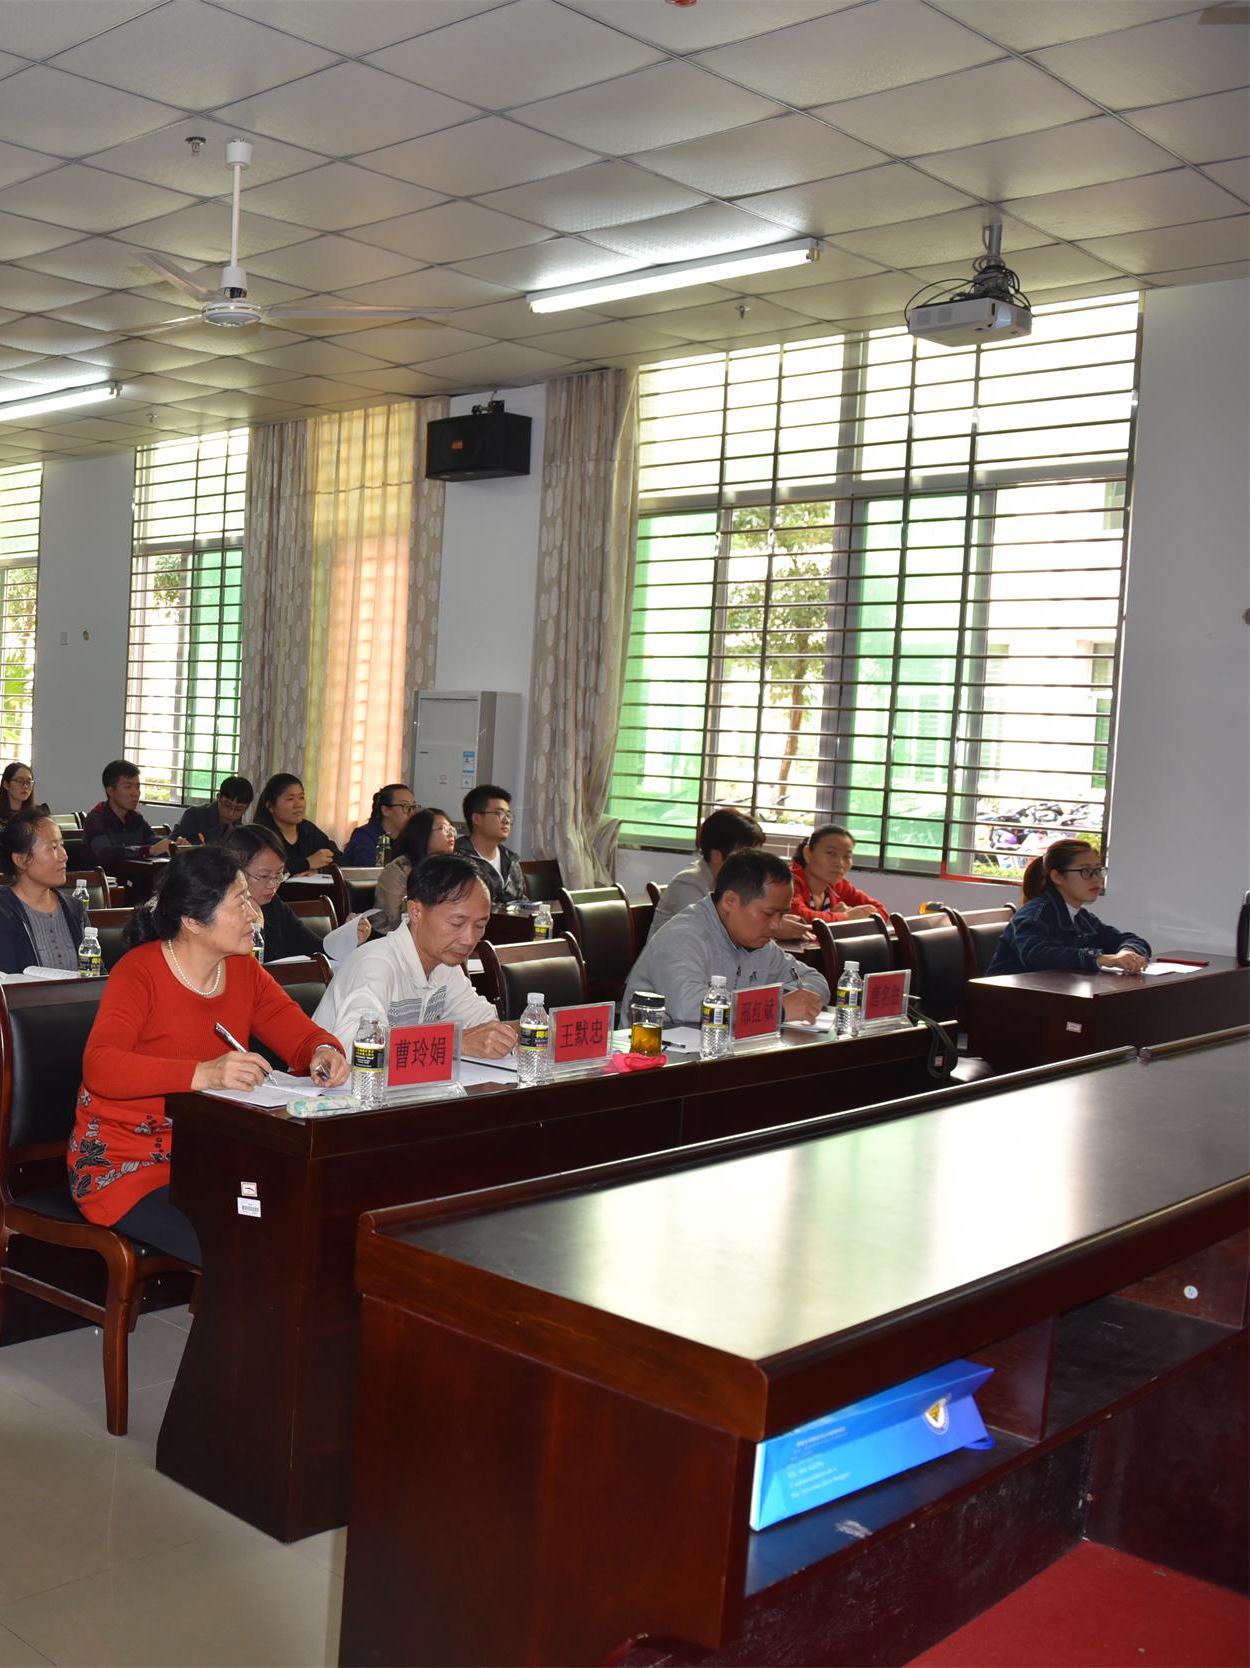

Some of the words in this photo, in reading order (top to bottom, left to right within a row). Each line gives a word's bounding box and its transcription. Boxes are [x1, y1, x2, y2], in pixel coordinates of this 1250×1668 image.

[560, 1019, 603, 1048] 王默忠
[395, 1037, 447, 1070] 曹玲娟
